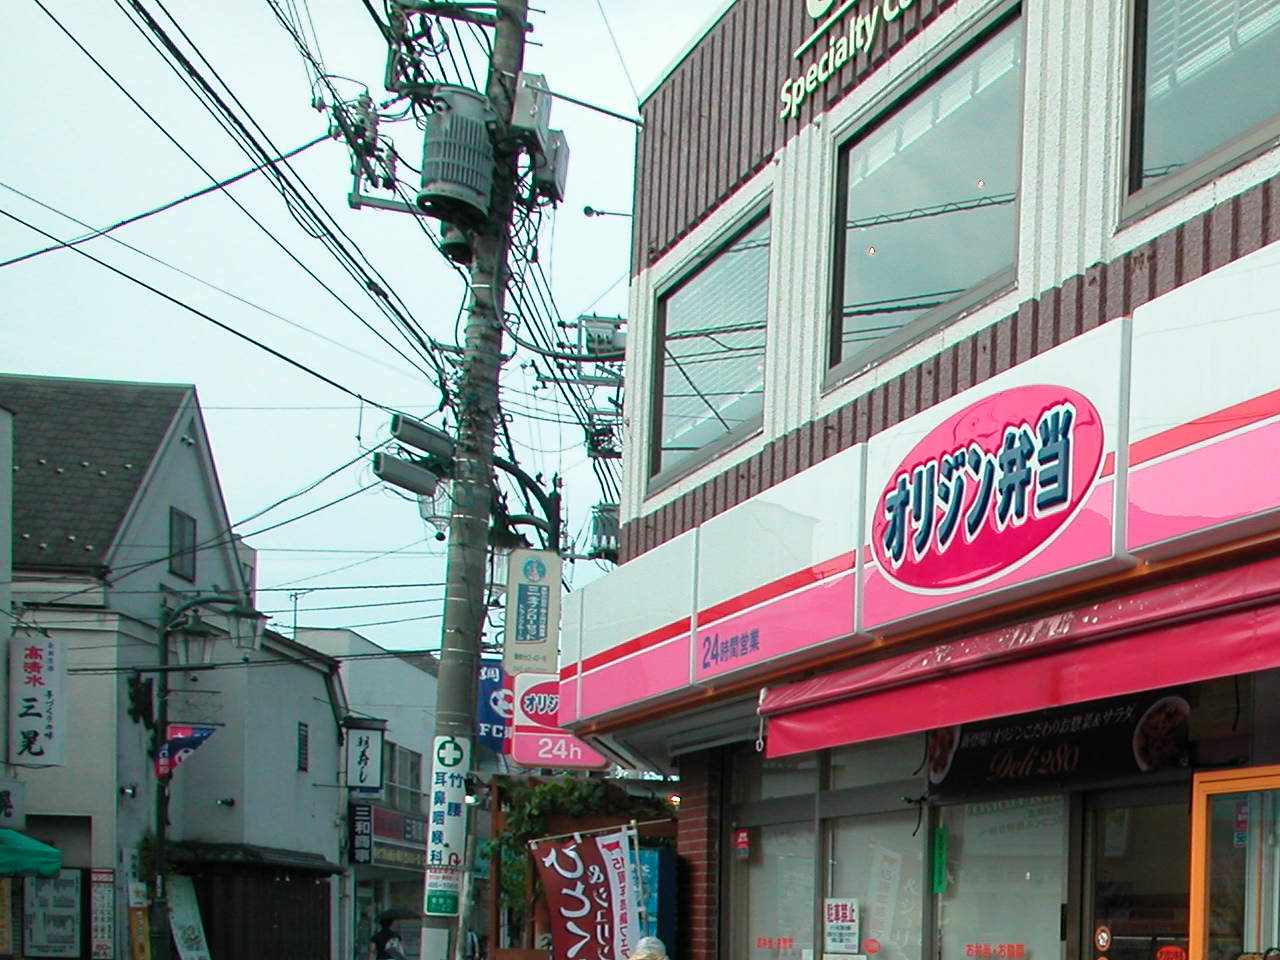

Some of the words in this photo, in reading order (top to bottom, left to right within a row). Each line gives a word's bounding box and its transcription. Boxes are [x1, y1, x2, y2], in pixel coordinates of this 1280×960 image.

[780, 5, 879, 119] Specialty
[883, 406, 1074, 563] オリジン弁当
[702, 628, 760, 669] 24時間営業
[537, 738, 582, 760] 24h
